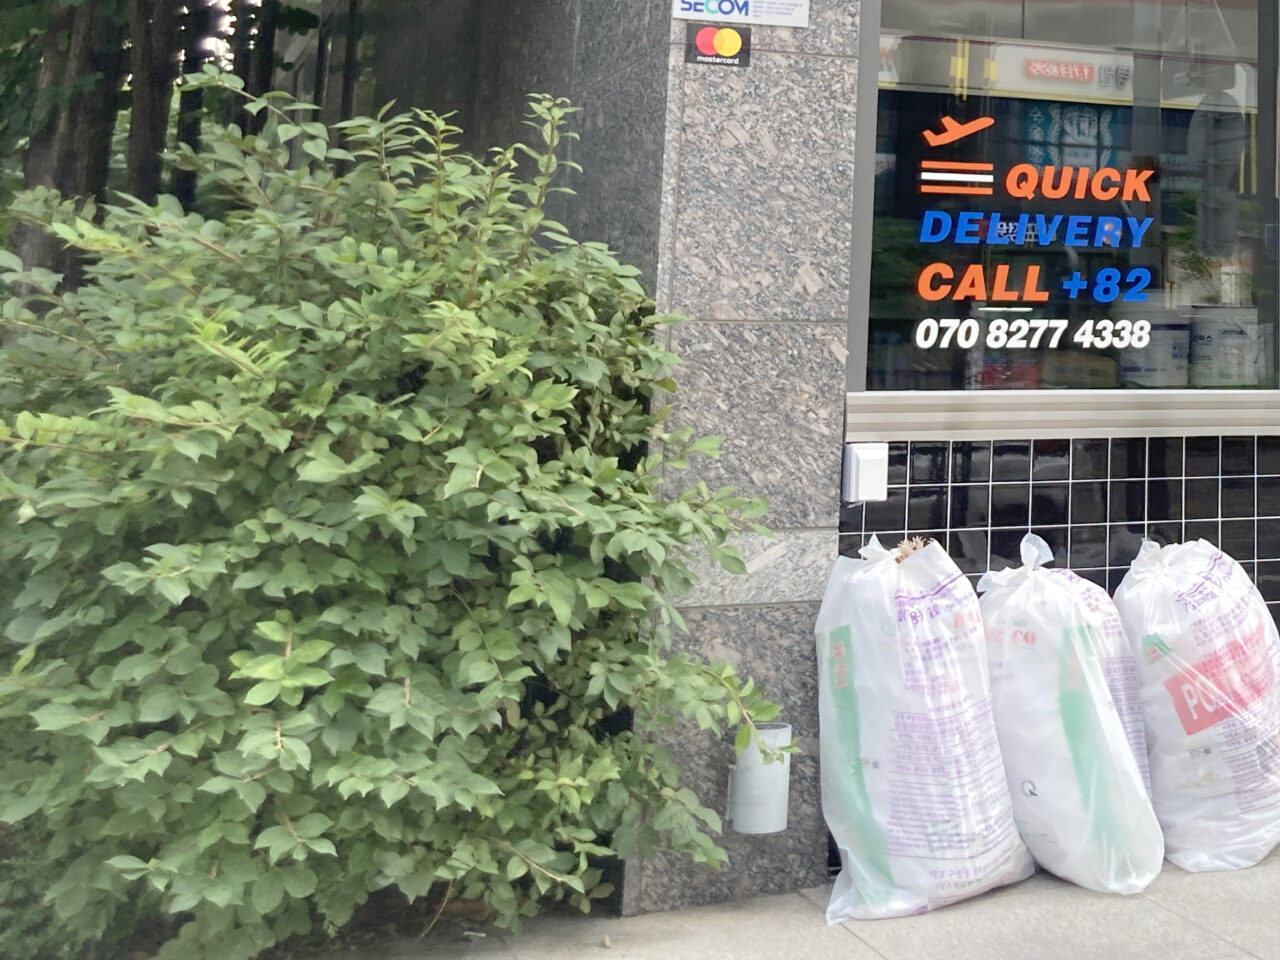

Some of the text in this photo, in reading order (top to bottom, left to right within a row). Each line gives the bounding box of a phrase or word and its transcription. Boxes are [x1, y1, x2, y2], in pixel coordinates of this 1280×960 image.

[696, 55, 740, 65] mastercard
[1006, 163, 1155, 203] QUICK
[919, 210, 1155, 249] DELIVERY
[917, 262, 1152, 303] CALL +82
[915, 318, 1151, 349] 070 8277 4338
